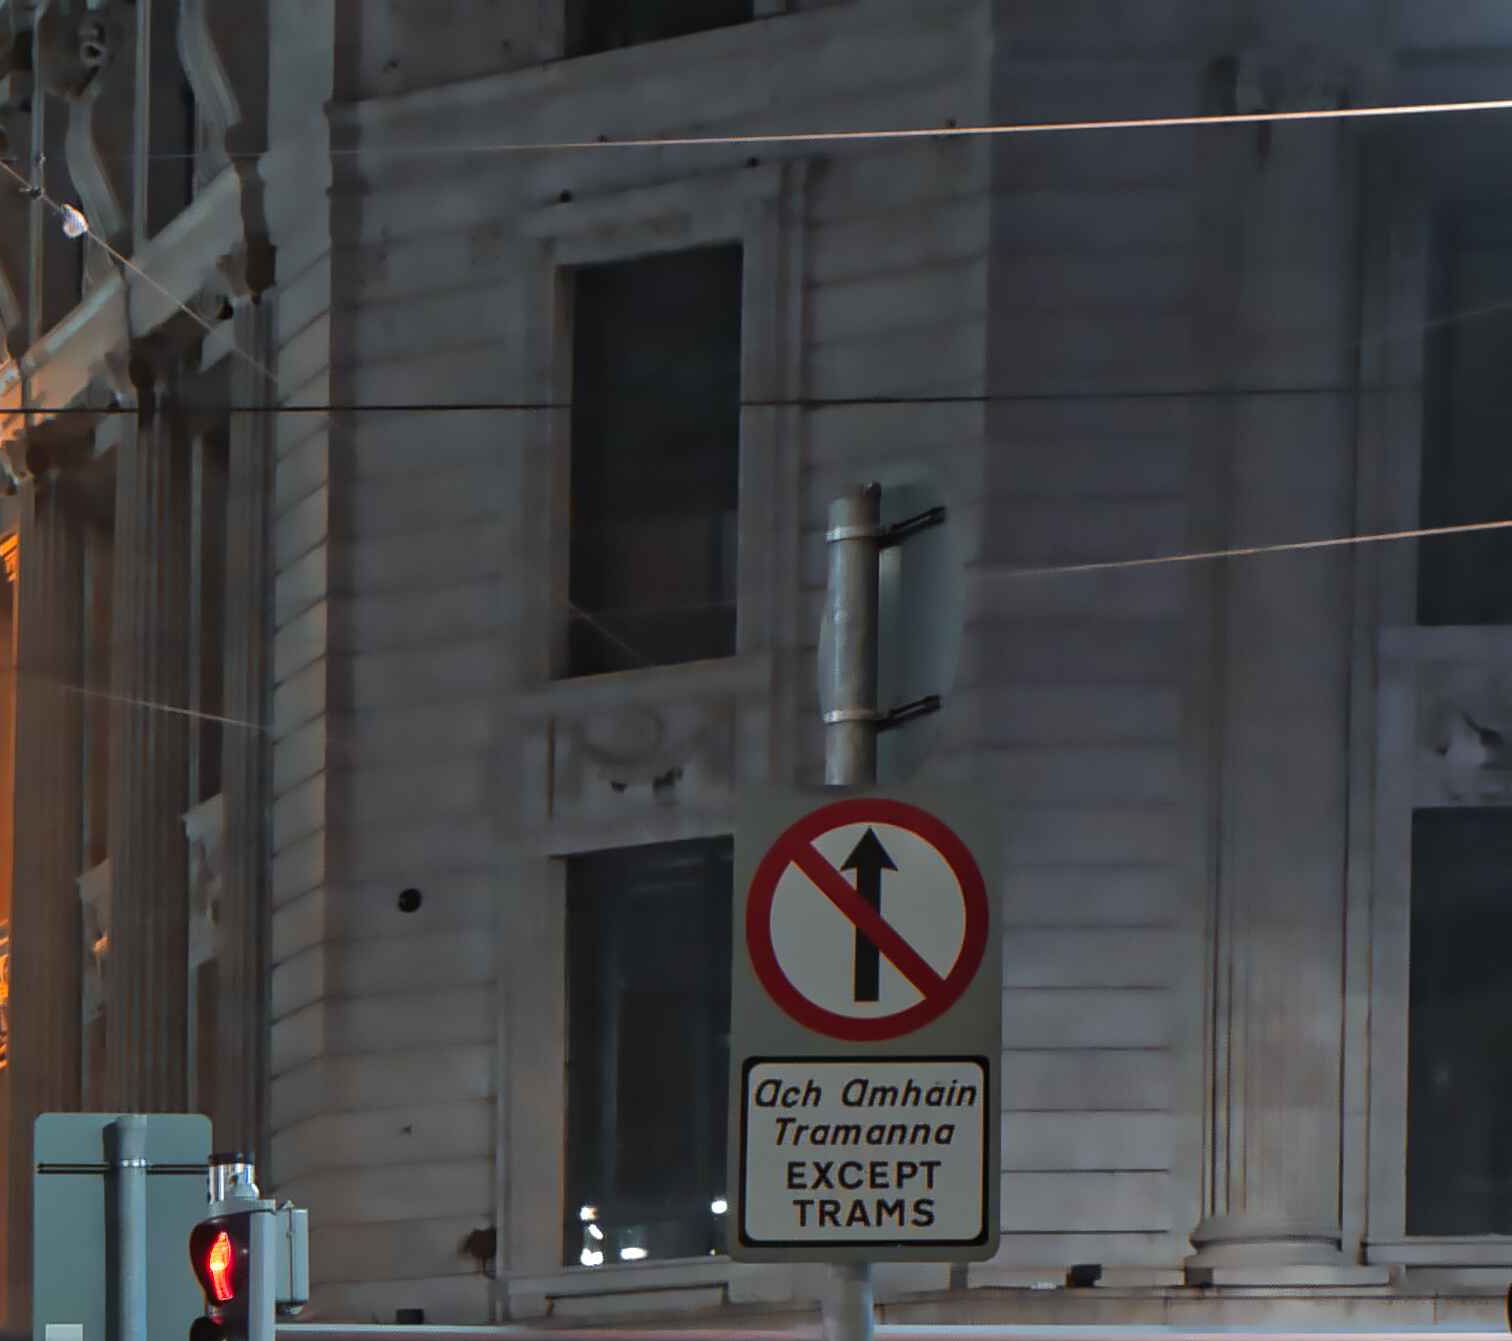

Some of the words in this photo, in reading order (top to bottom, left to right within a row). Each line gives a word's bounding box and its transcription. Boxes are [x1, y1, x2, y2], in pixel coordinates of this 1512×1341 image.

[754, 1078, 822, 1108] Ach
[775, 1117, 956, 1146] Tramanna
[786, 1160, 942, 1191] EXCEPT
[792, 1198, 936, 1228] TRAMS
